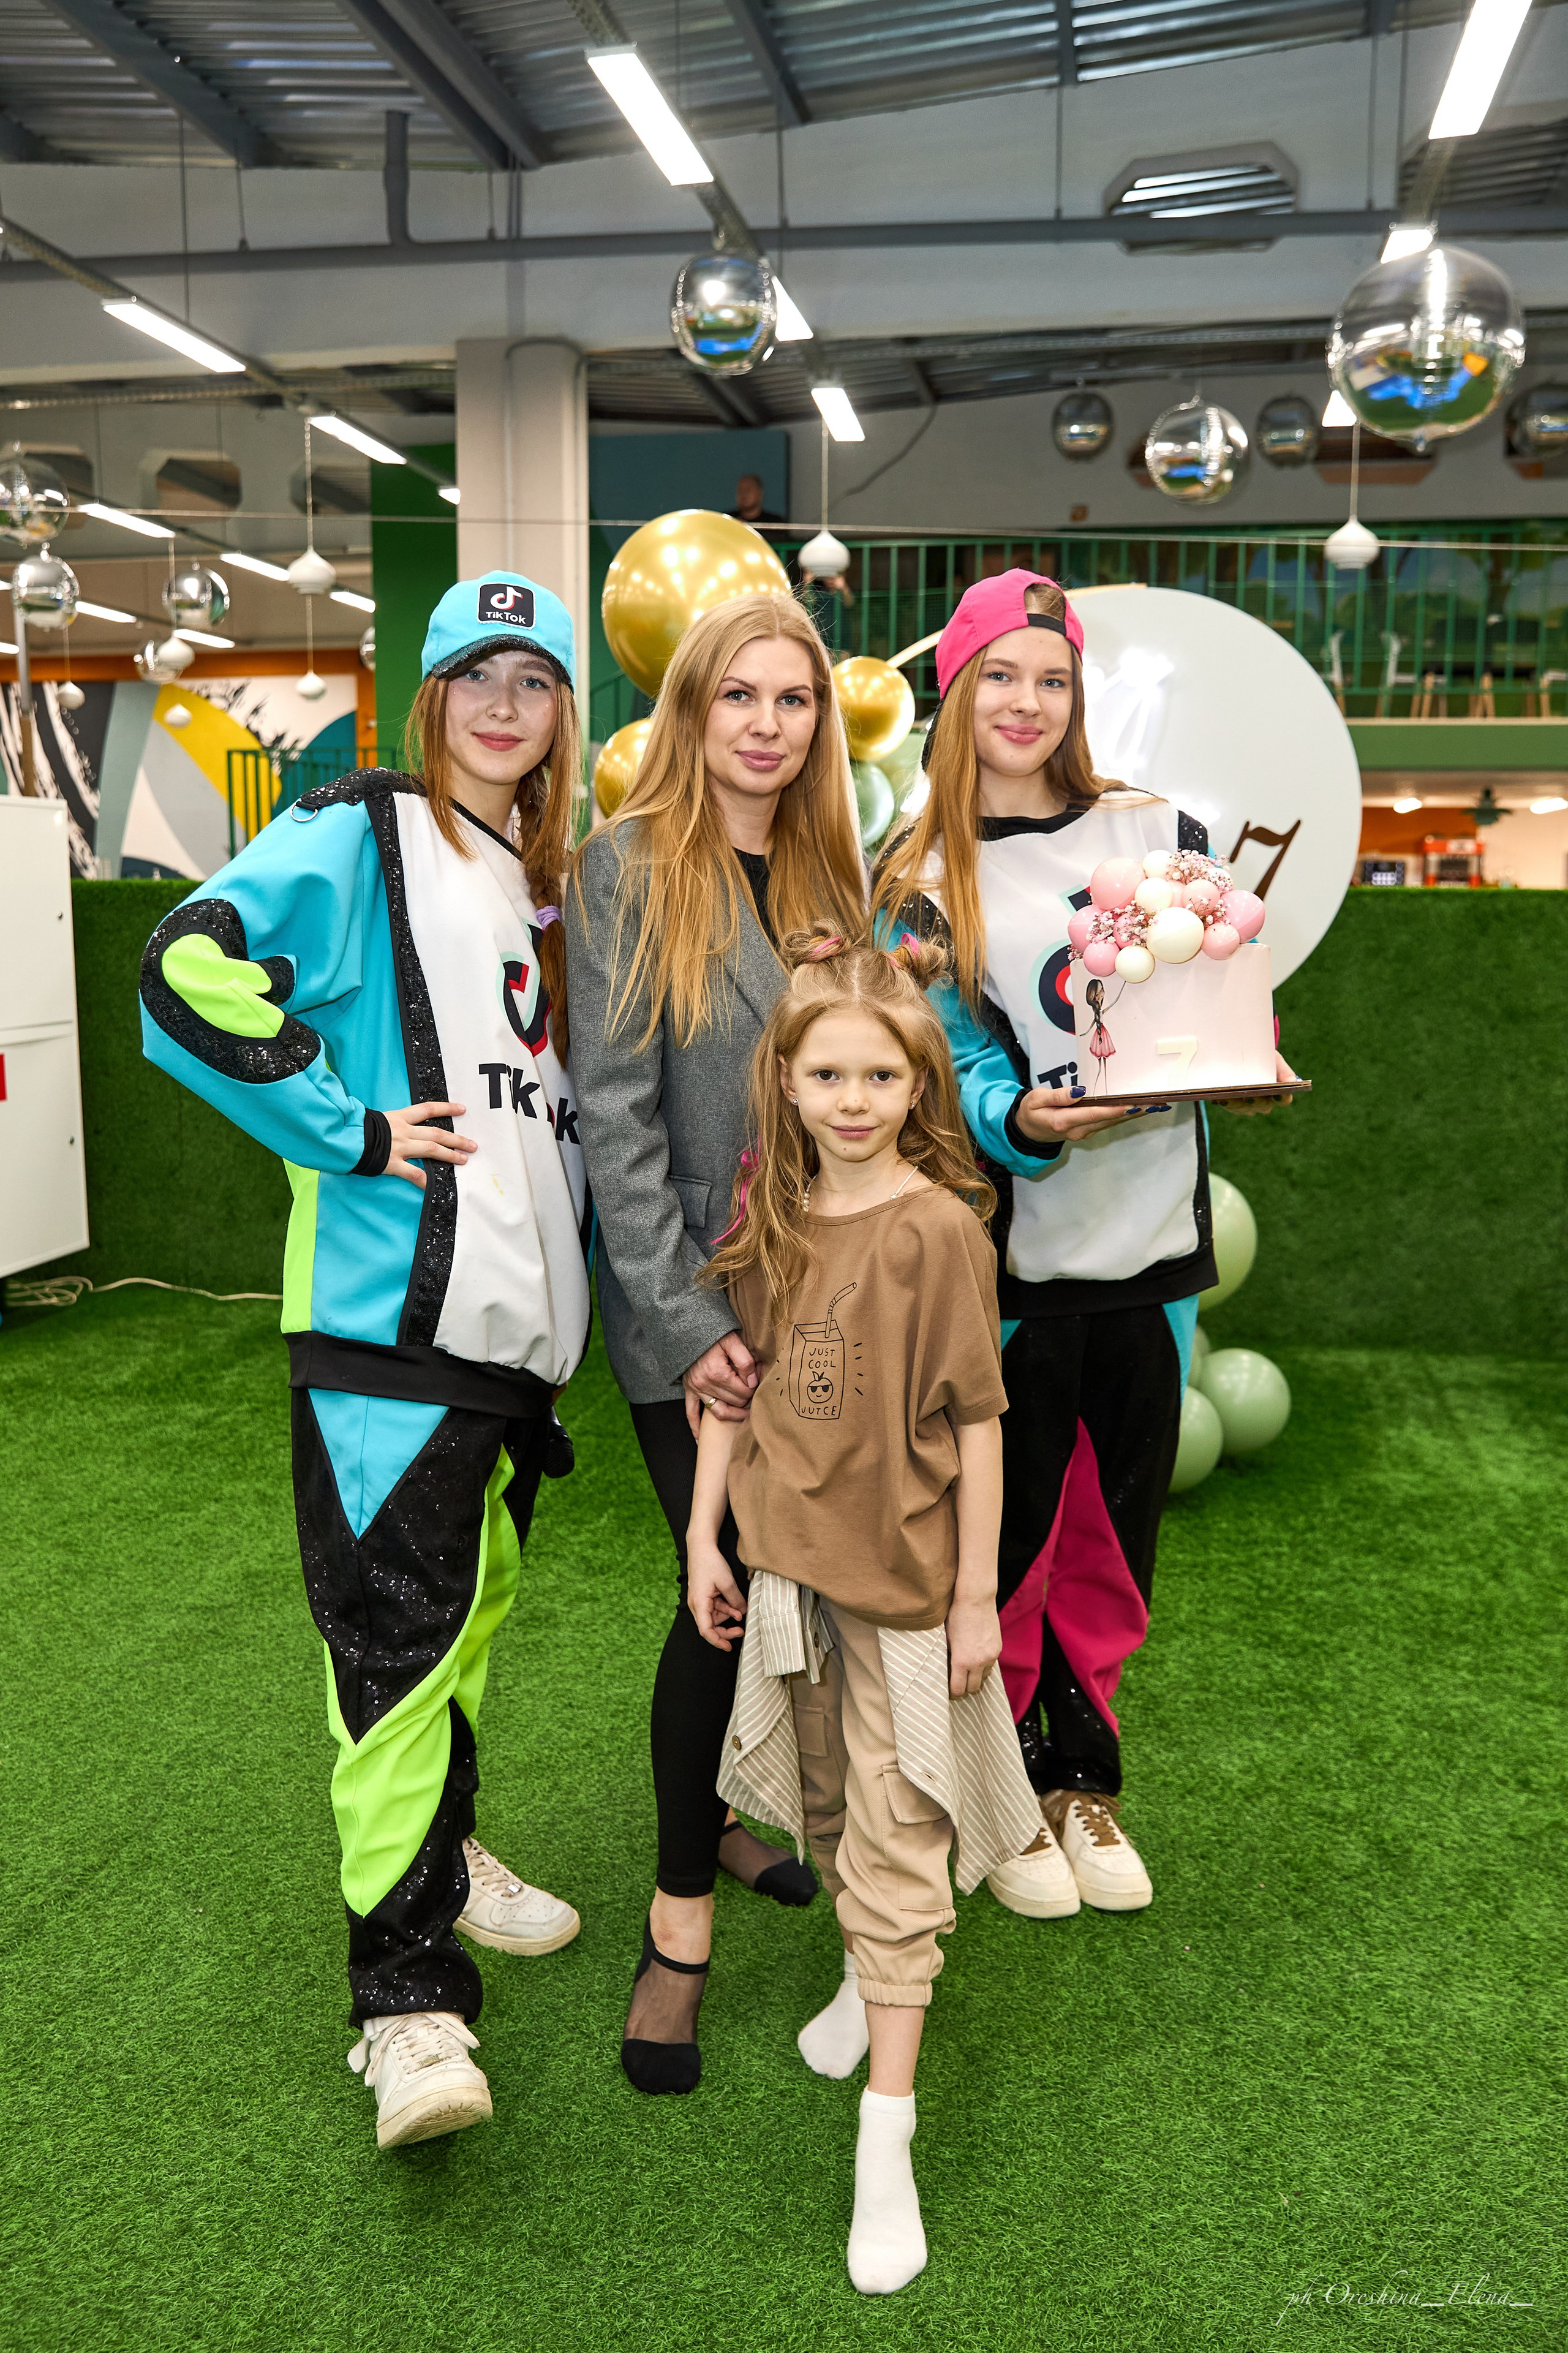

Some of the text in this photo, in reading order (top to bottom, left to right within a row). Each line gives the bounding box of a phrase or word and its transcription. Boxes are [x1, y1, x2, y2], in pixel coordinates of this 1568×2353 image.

[485, 611, 526, 624] TikTok
[1155, 1035, 1199, 1089] 7
[809, 1348, 835, 1356] JUST
[808, 1359, 836, 1369] COOL
